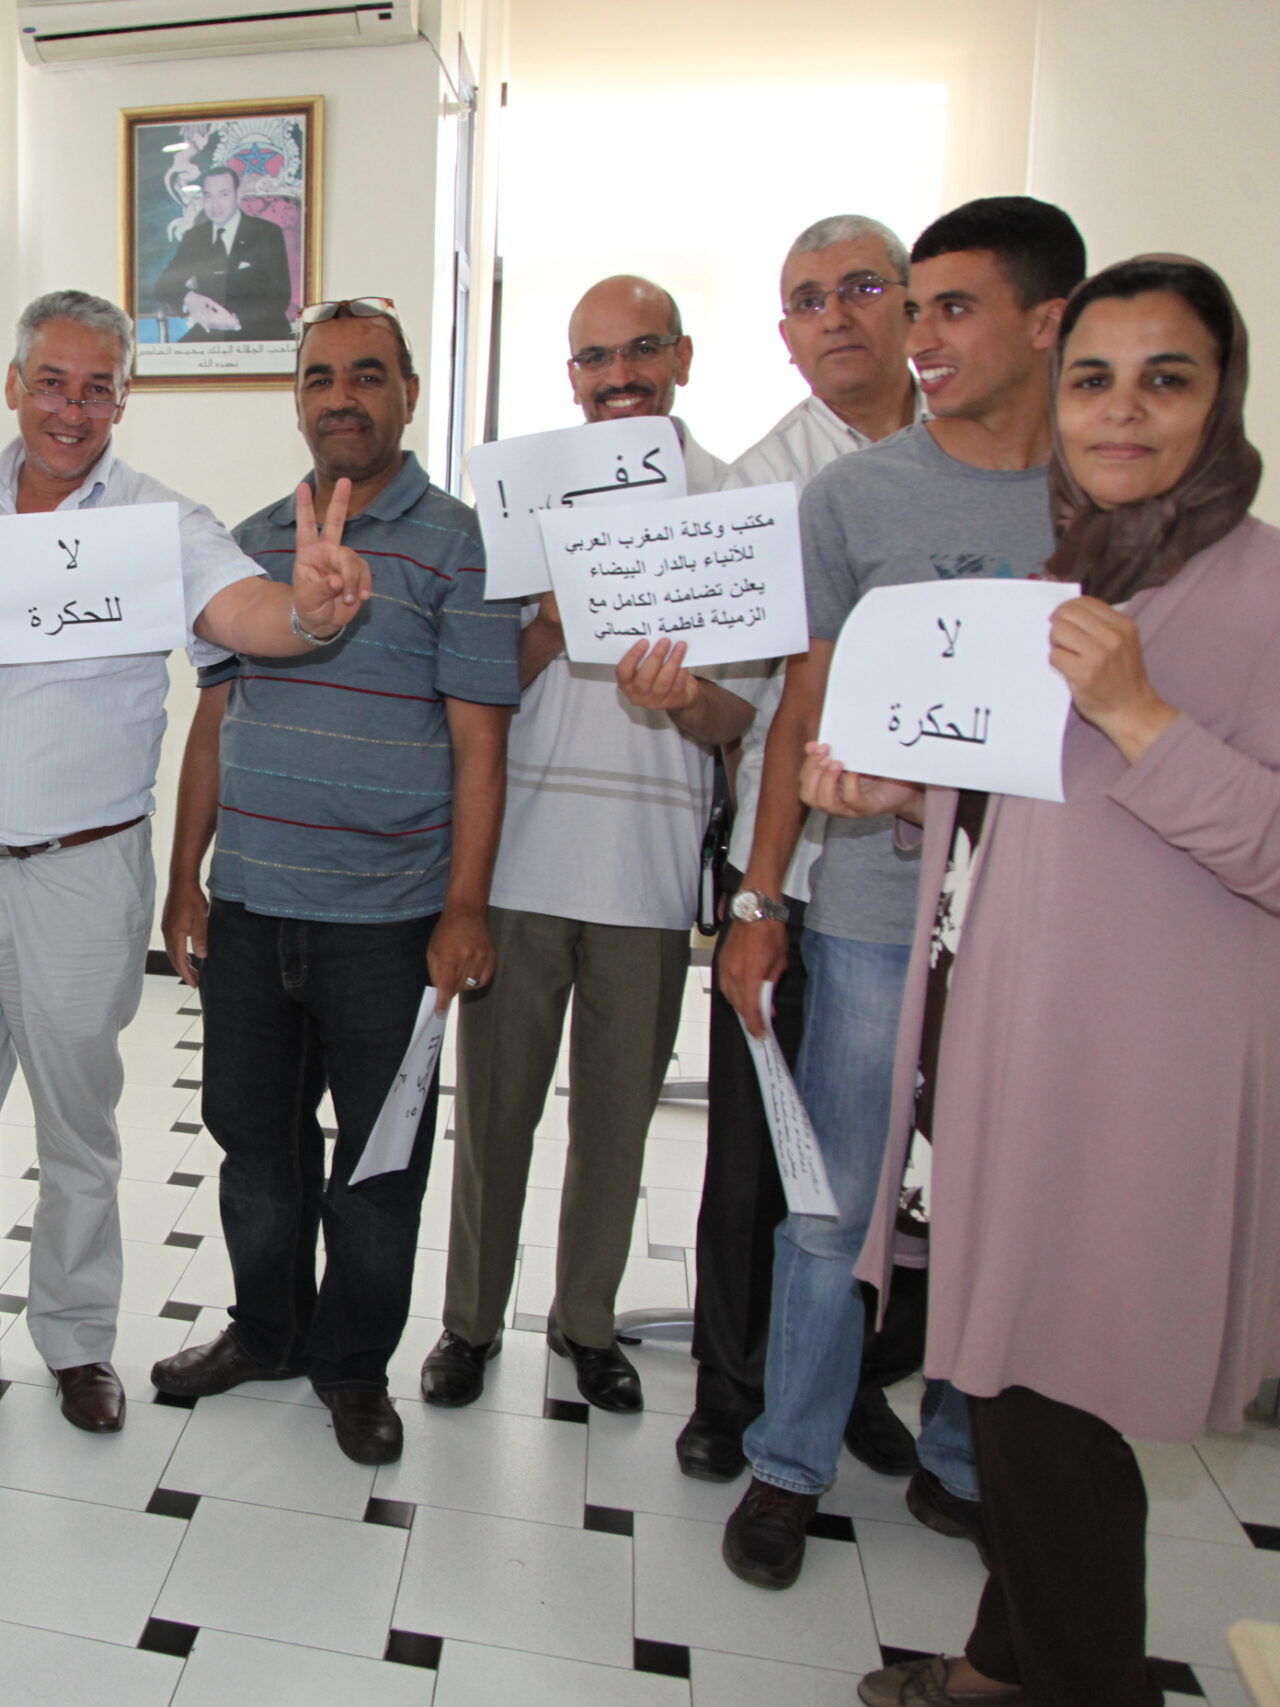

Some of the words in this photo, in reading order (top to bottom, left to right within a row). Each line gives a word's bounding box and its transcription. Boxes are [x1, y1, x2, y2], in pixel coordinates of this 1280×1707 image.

[681, 521, 724, 538] وكالة
[731, 514, 775, 534] مكتب
[565, 532, 611, 555] العربي
[618, 526, 674, 549] المغرب
[58, 539, 80, 570] لا
[590, 560, 646, 579] البيضاء
[654, 555, 696, 577] بالدار
[664, 583, 723, 603] تضامنه
[730, 578, 765, 598] يعلن
[589, 598, 607, 614] مع
[613, 592, 657, 611] الكامل
[28, 596, 123, 636] للحكرة
[658, 612, 705, 633] فاطمة
[711, 607, 766, 629] الزميلة
[594, 622, 651, 642] الحساني
[937, 618, 962, 658] لا
[888, 703, 991, 747] للحكرة
